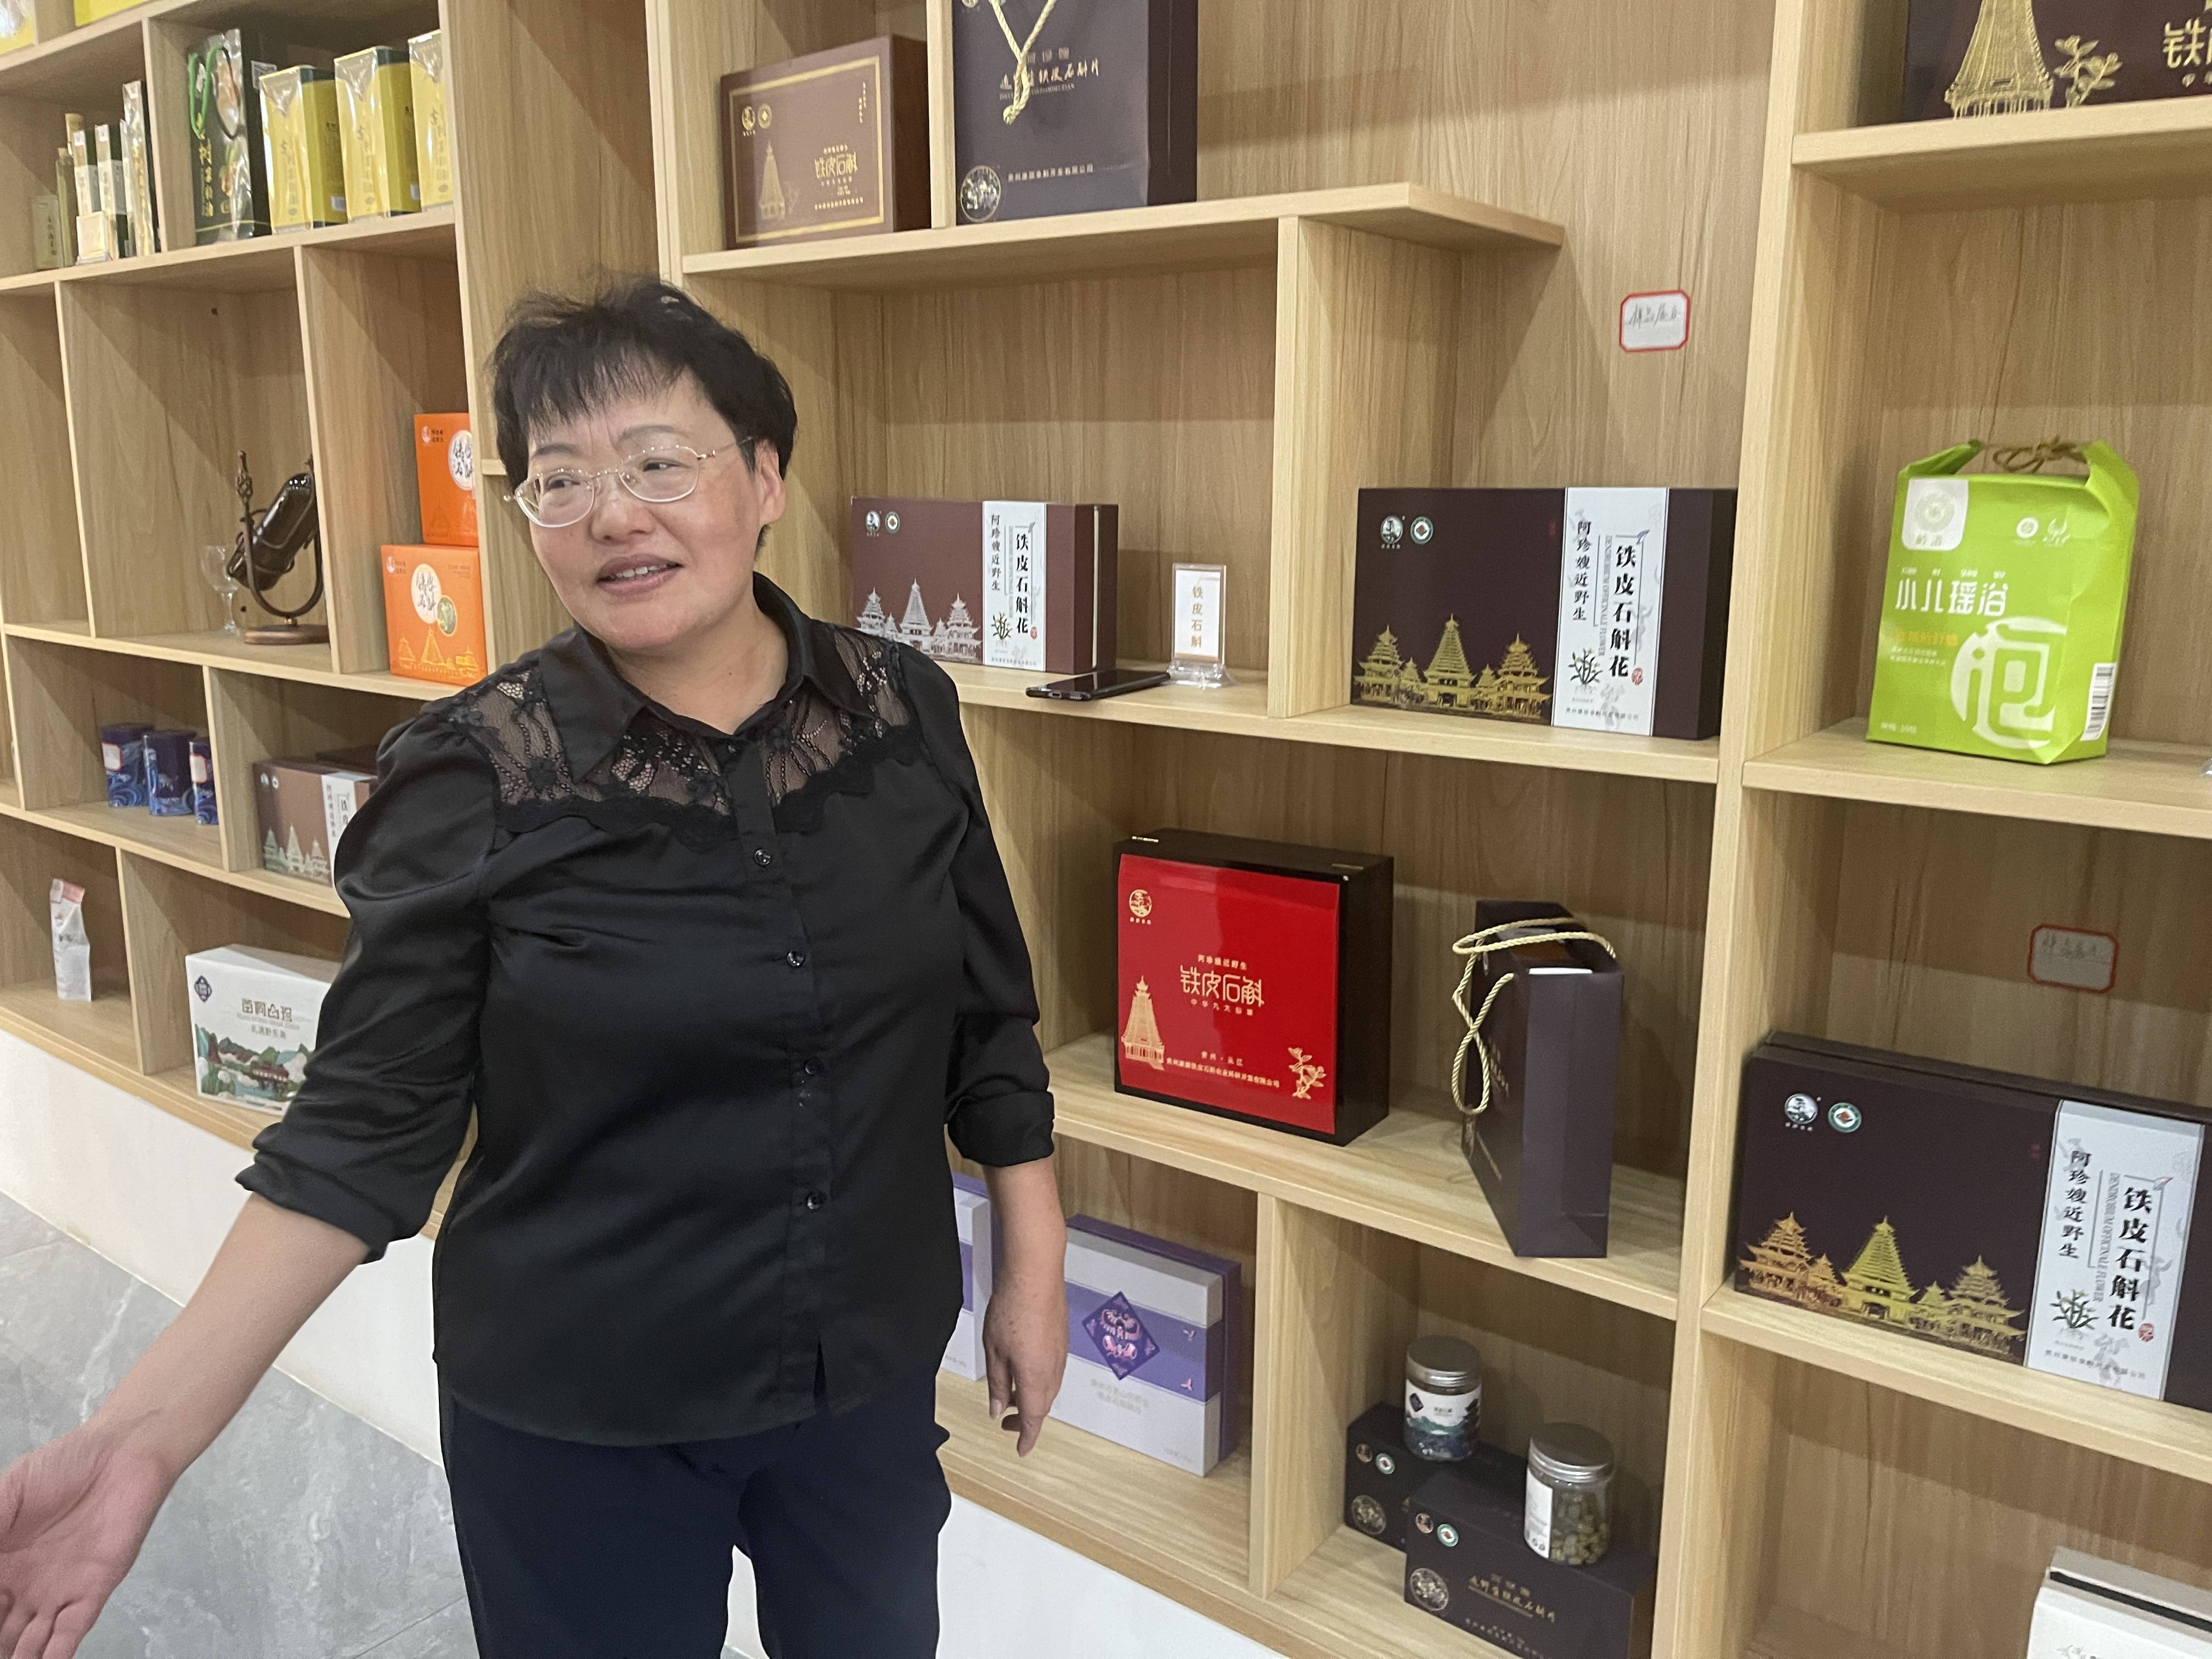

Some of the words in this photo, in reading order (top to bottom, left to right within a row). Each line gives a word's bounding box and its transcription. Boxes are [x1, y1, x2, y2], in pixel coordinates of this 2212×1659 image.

[2163, 17, 2212, 68] 铁
[1015, 533, 1029, 634] 铁皮石斛花
[1609, 545, 1636, 678] 铁皮石斛花
[1894, 578, 2008, 617] 小儿瑶浴
[1190, 585, 1204, 648] 铁皮石斛
[1180, 964, 1265, 1007] 铁皮石斛
[2107, 1187, 2152, 1330] 铁皮石斛花
